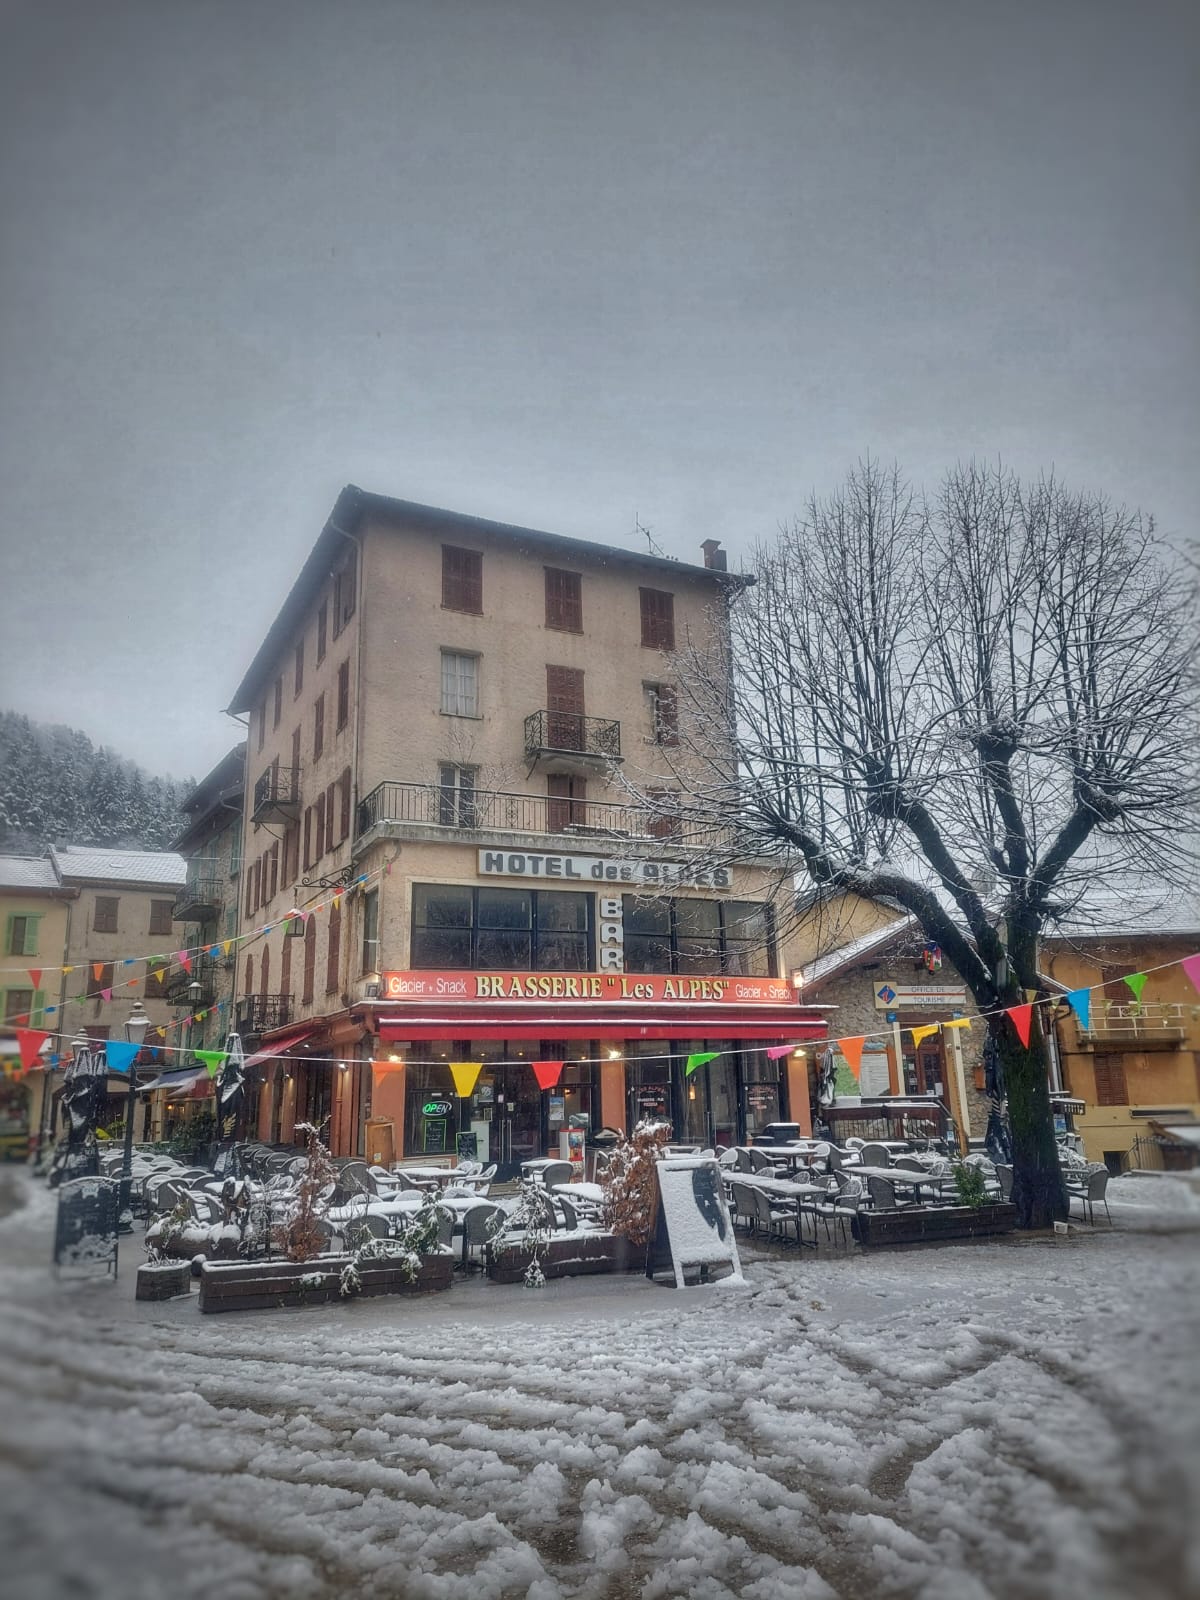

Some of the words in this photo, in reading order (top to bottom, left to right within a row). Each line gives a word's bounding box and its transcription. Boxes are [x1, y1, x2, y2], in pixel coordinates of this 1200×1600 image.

[485, 852, 581, 878] HOTEL
[591, 860, 632, 880] des
[600, 898, 624, 969] BAR
[390, 976, 425, 993] Glacier
[436, 977, 467, 993] Snack
[475, 975, 603, 999] BRASSERIE
[735, 983, 762, 998] Glacier
[768, 984, 792, 1000] Snack
[424, 1103, 448, 1113] OPEN
